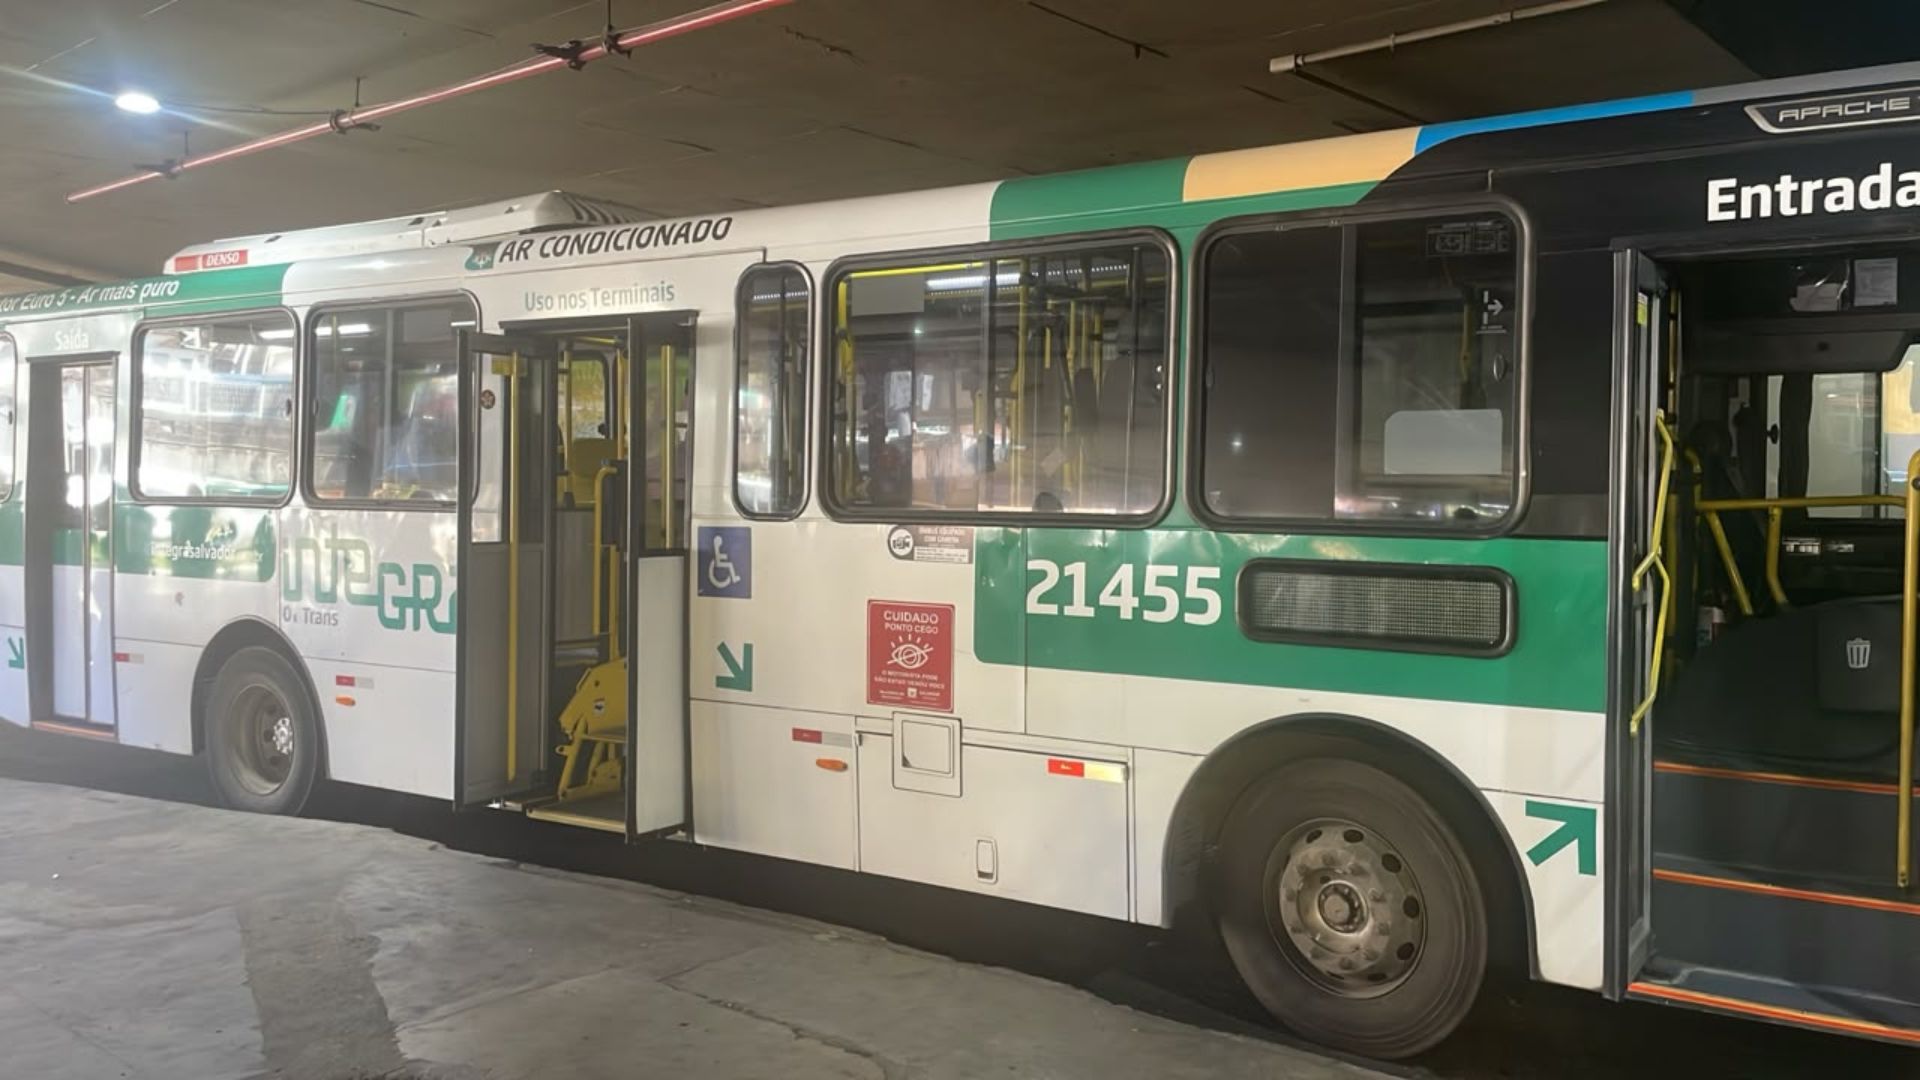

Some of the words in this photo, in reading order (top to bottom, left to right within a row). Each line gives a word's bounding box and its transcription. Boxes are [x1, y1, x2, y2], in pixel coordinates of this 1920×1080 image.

[1778, 97, 1911, 123] APACHE
[1707, 162, 1920, 222] Entrada
[499, 239, 535, 263] AR
[539, 216, 733, 259] CONDICIONADO
[206, 251, 240, 266] DENSO
[20, 293, 54, 310] Euro
[56, 289, 69, 306] 5
[77, 287, 96, 304] Ar
[99, 281, 139, 301] mais
[139, 279, 180, 303] puro
[524, 291, 555, 312] Uso
[558, 288, 587, 310] nos
[589, 281, 675, 308] Terminais
[54, 327, 90, 350] Saída
[1026, 559, 1222, 626] 21455
[302, 607, 339, 627] Trans
[883, 610, 940, 625] CUIDADO
[884, 622, 913, 634] PONTO
[914, 624, 939, 635] CEGO
